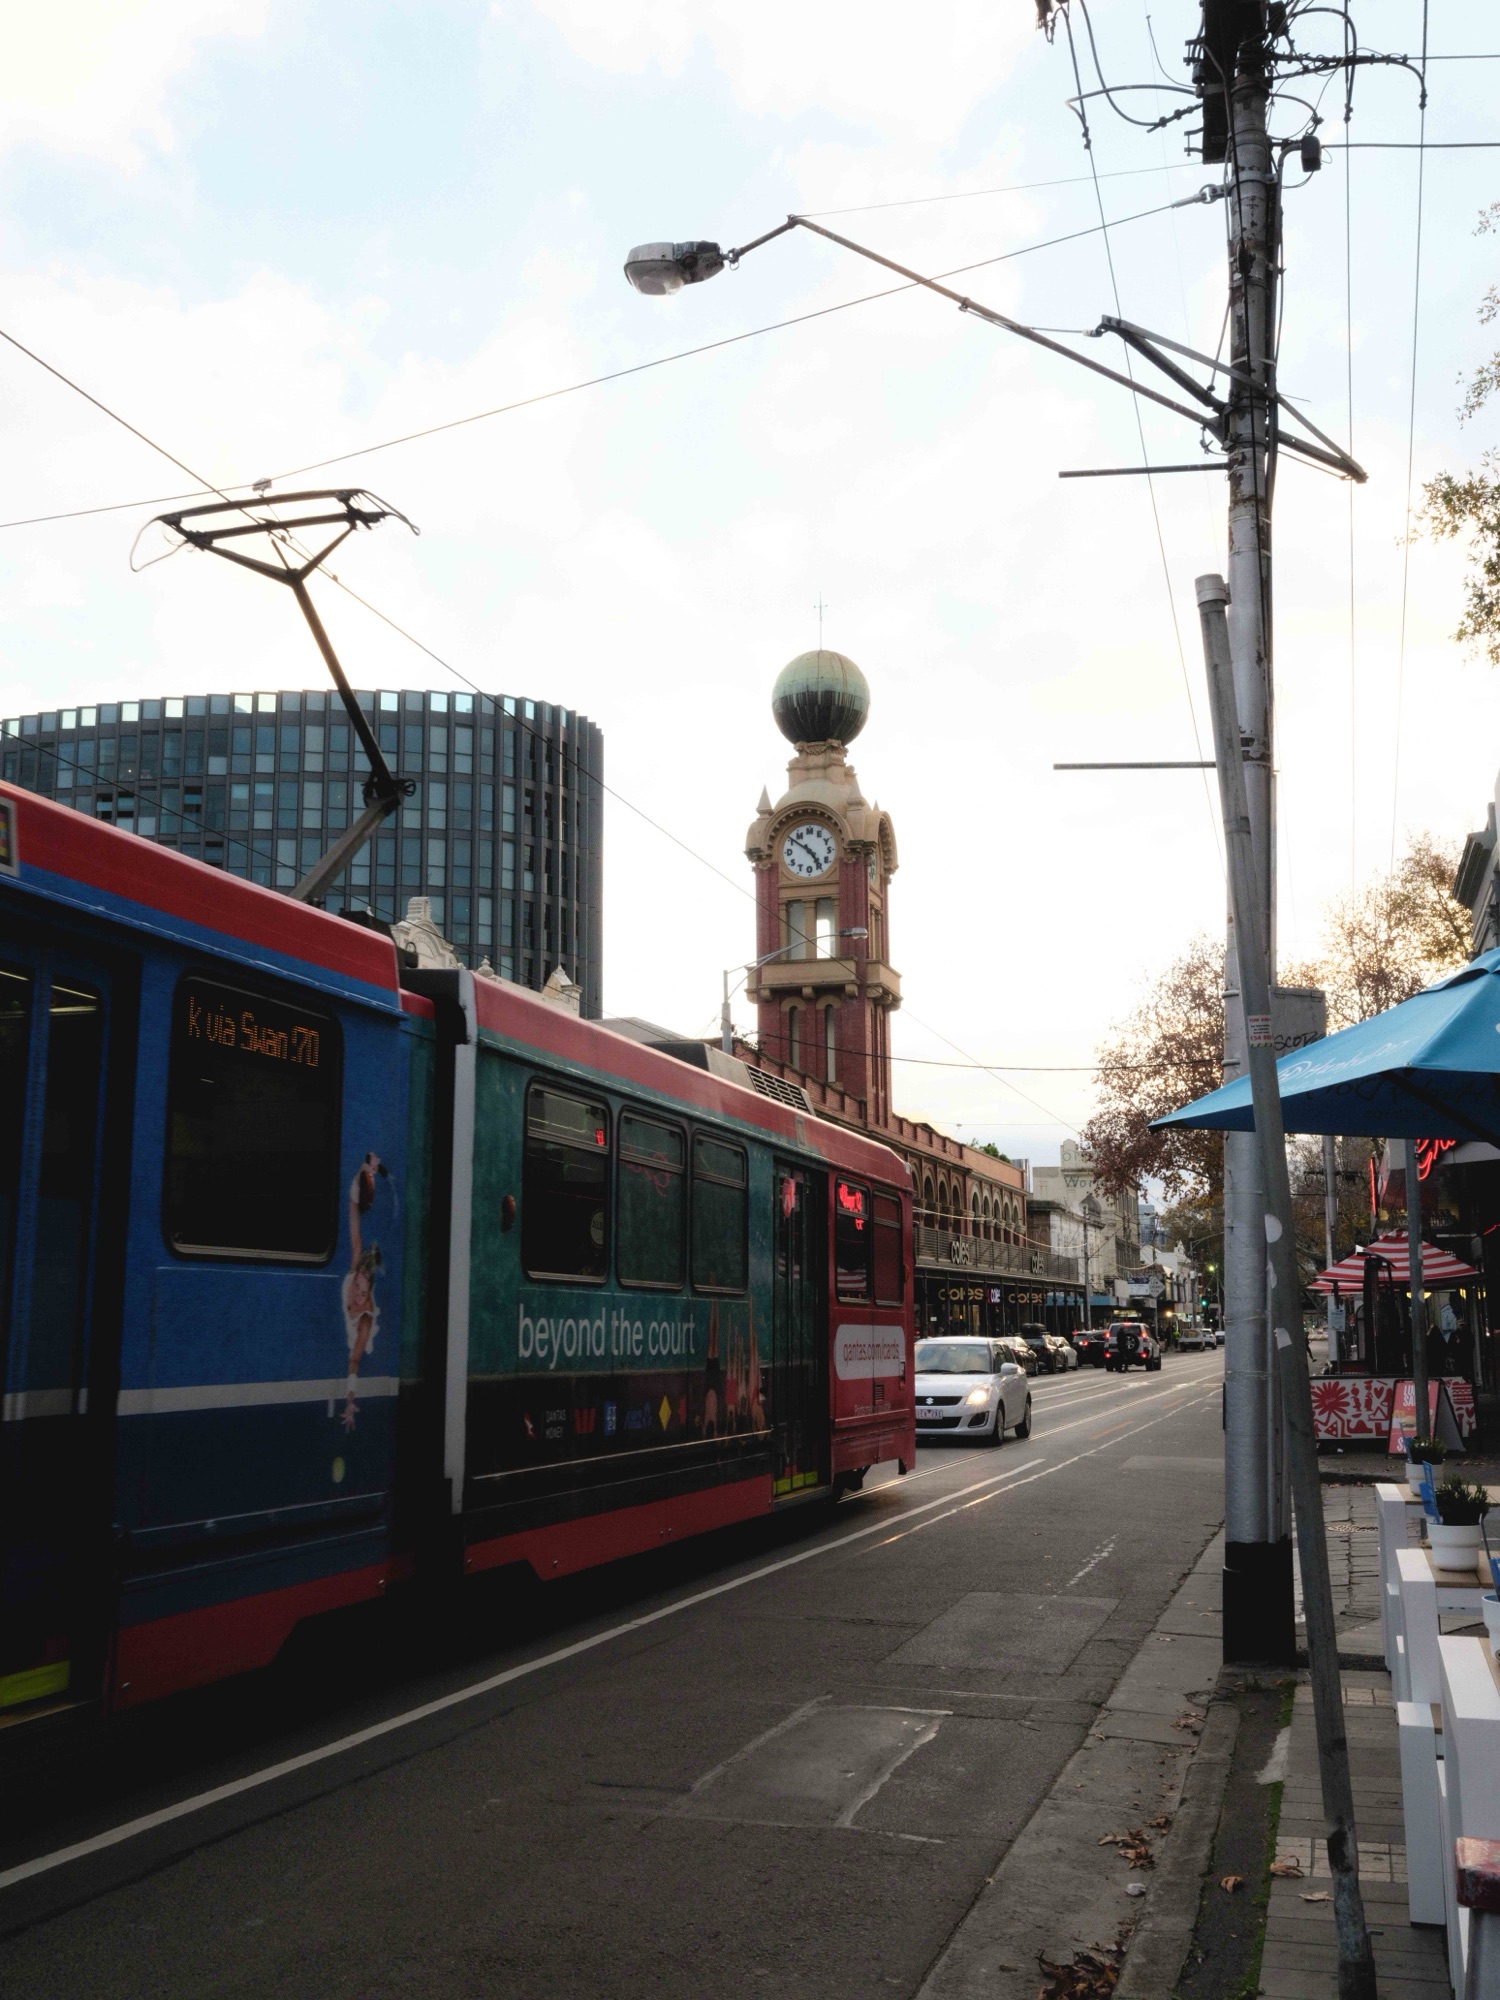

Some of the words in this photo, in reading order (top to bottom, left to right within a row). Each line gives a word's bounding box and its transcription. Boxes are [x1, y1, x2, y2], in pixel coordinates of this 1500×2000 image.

[206, 1005, 235, 1047] via
[240, 1010, 288, 1060] Swan
[951, 1235, 970, 1265] coles
[1031, 1250, 1044, 1274] coles
[938, 1287, 984, 1301] coles
[1008, 1292, 1046, 1304] coles
[518, 1303, 605, 1370] beyond
[611, 1307, 643, 1356] the
[648, 1313, 695, 1355] court
